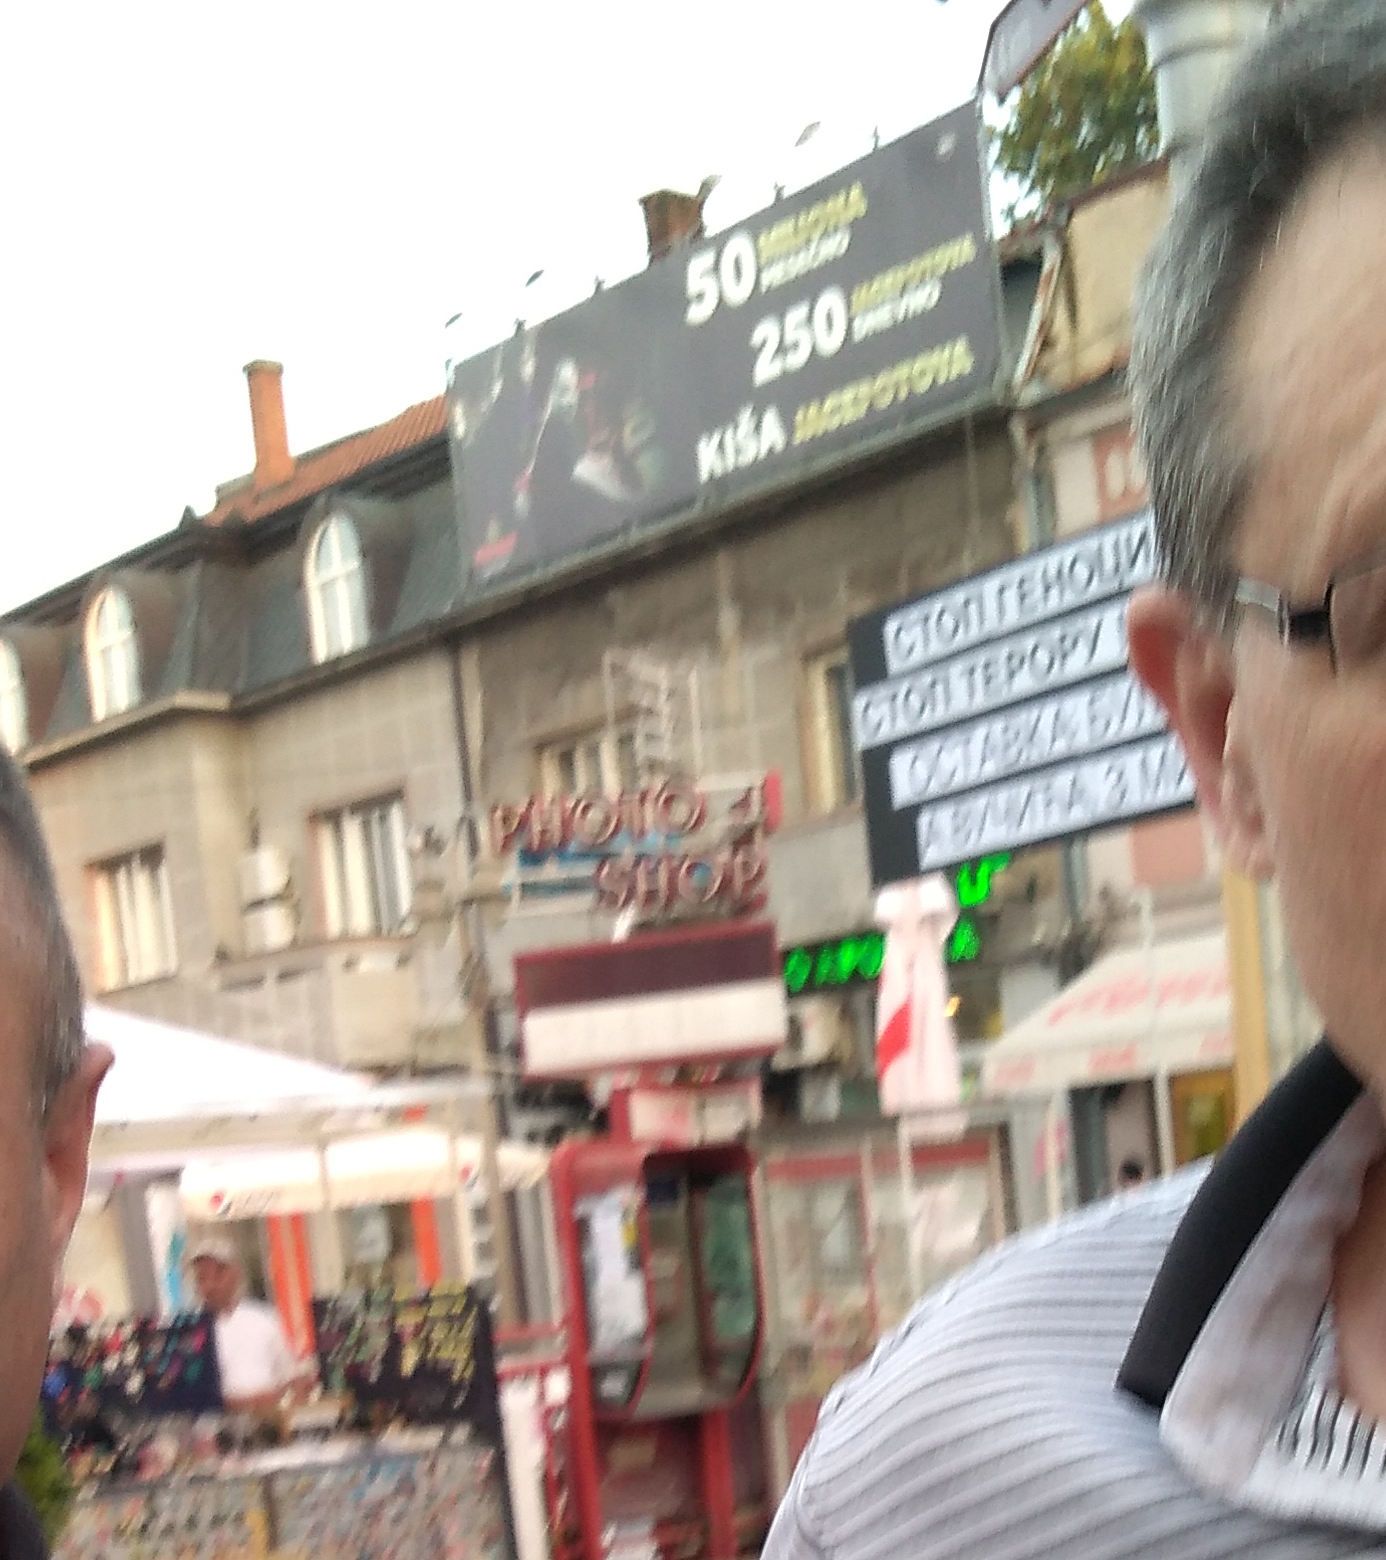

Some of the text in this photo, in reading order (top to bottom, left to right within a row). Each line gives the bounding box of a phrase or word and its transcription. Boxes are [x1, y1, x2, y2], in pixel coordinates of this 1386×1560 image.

[685, 229, 757, 326] 50
[751, 285, 849, 388] 250
[696, 402, 787, 485] KIŠA
[995, 524, 1152, 622] ГЕНОЦИ
[488, 776, 708, 854] PHOTO
[593, 836, 769, 910] SHOP
